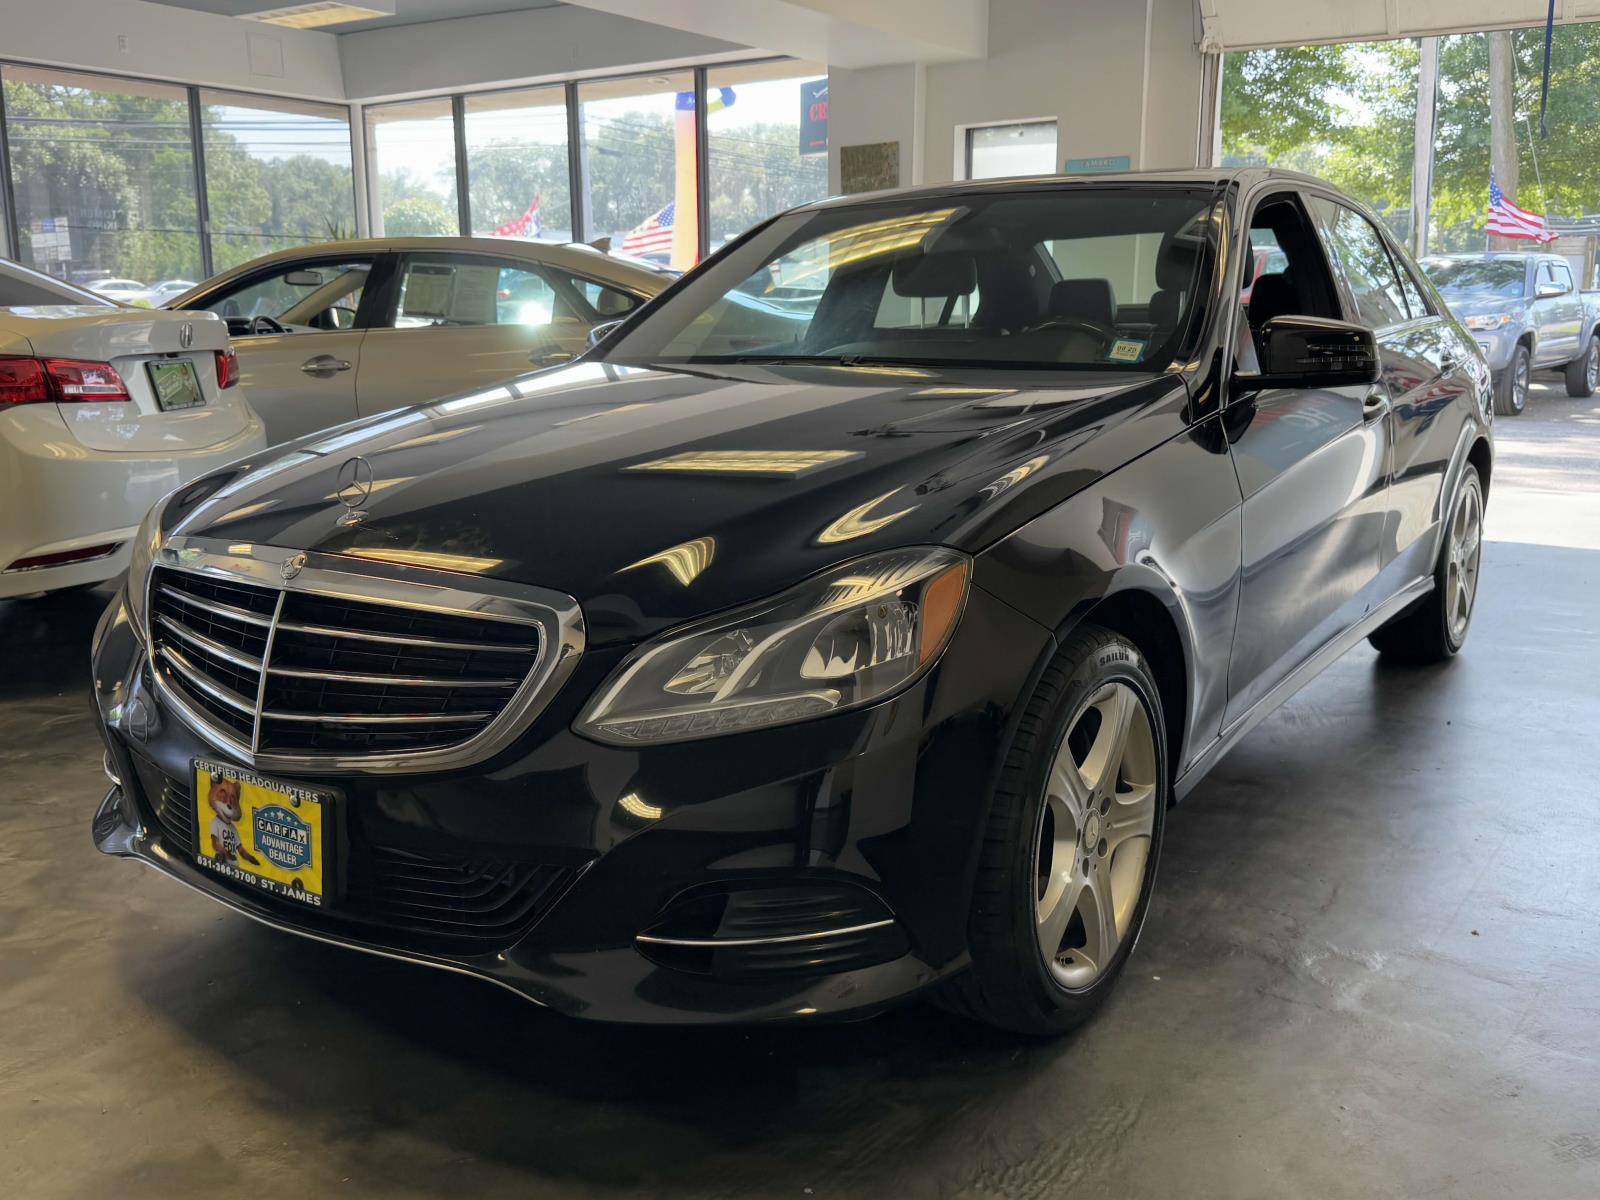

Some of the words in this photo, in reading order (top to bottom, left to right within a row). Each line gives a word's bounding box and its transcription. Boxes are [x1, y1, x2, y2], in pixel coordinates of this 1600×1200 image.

[194, 760, 237, 779] CERTIFIED
[239, 773, 319, 803] HEADQUARTERS
[258, 819, 307, 845] CARFAX
[261, 834, 304, 856] ADVANTAGE
[269, 848, 297, 866] DEALER
[261, 879, 279, 893] ST.
[281, 887, 321, 906] JAMES
